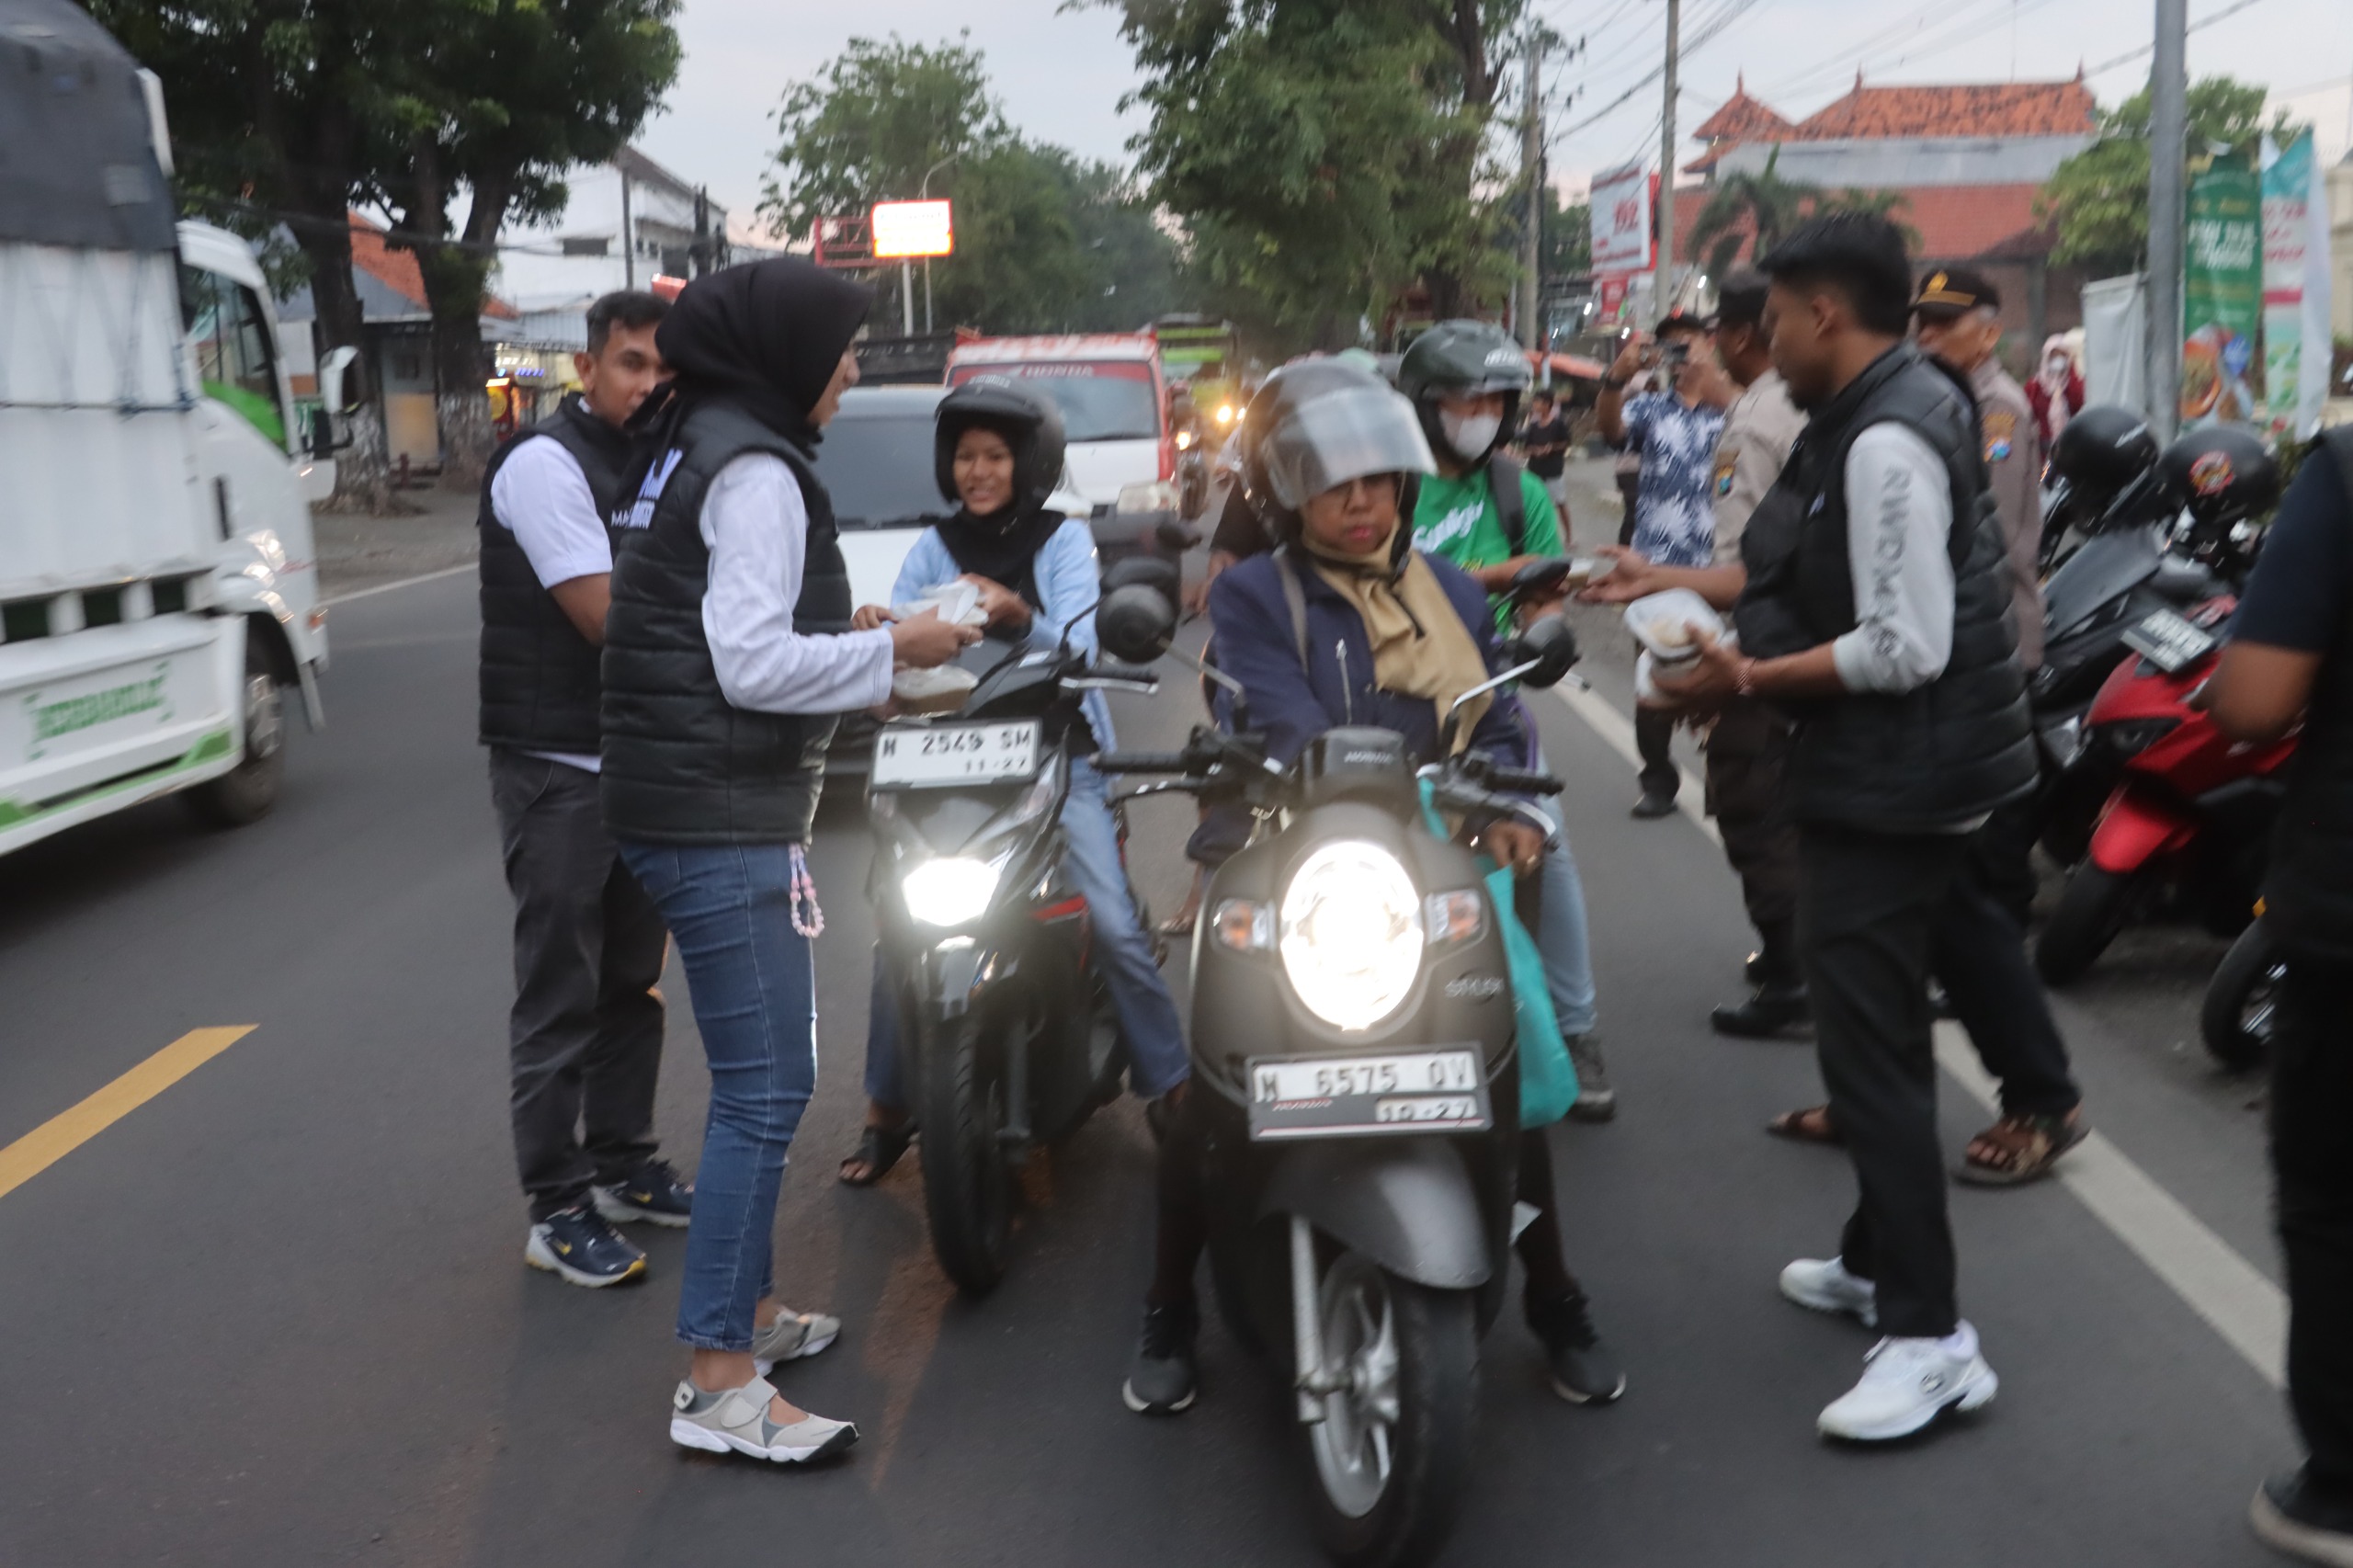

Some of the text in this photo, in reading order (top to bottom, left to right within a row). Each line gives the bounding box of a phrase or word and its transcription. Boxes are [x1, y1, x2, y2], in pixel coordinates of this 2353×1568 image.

[921, 733, 983, 755] 2549
[1000, 730, 1030, 750] SM
[1315, 1063, 1397, 1096] 6575
